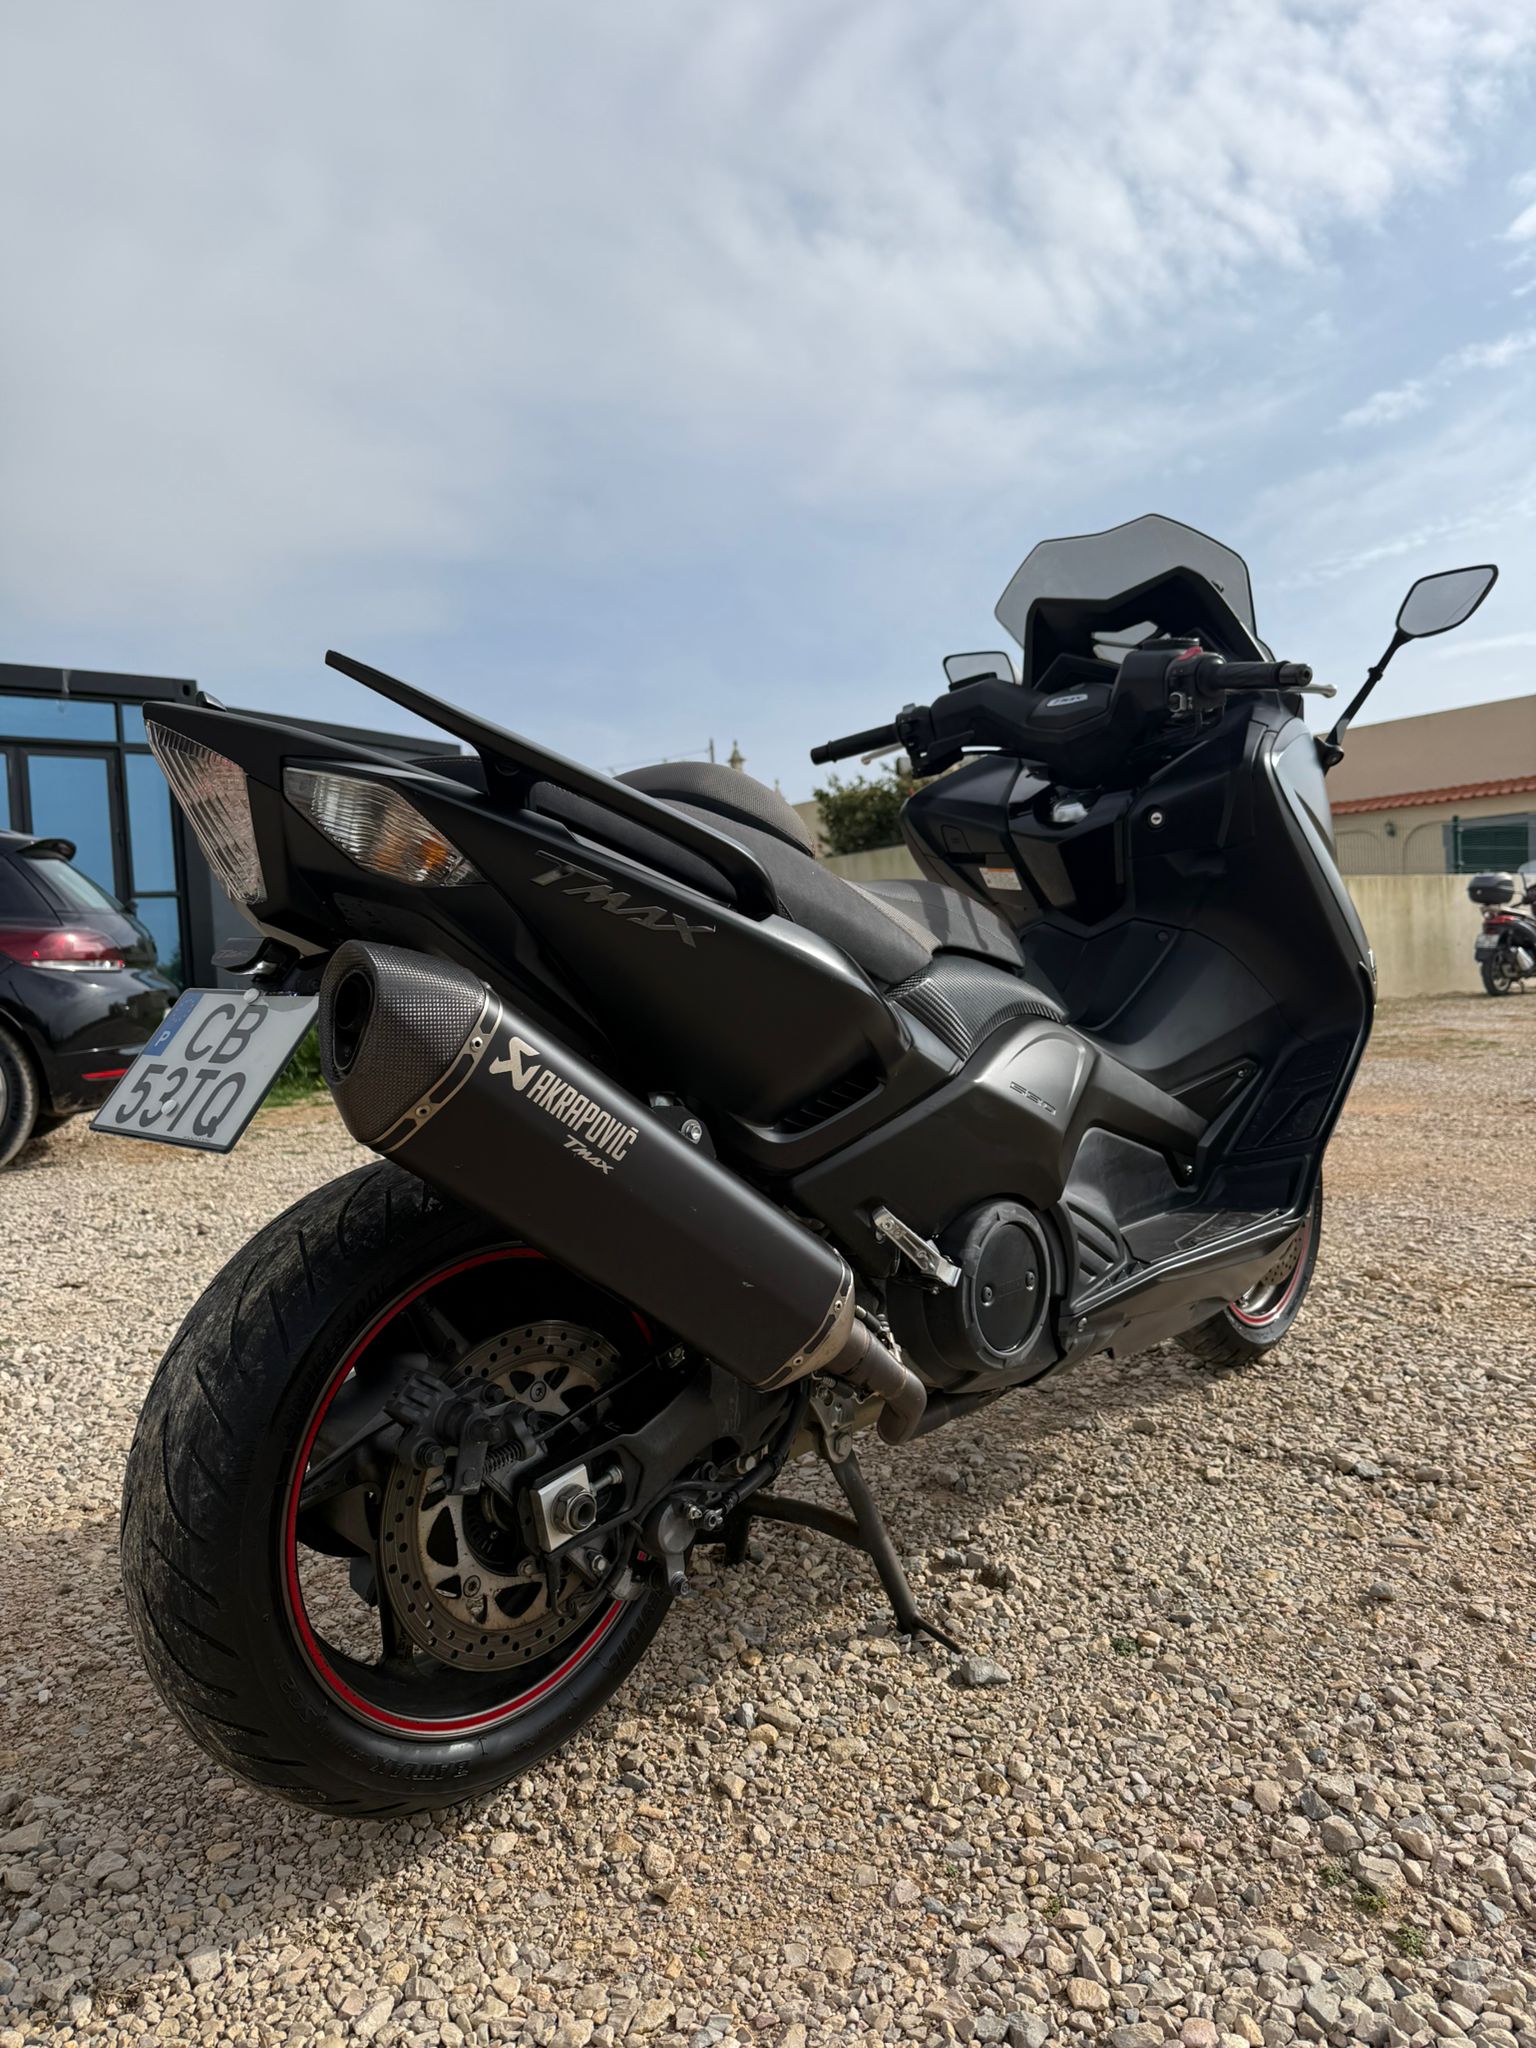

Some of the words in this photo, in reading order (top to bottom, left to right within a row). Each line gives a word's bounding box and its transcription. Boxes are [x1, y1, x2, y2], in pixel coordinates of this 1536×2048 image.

[530, 850, 716, 948] TMAX
[154, 1030, 171, 1047] P
[184, 1003, 269, 1064] CB
[115, 1064, 247, 1138] 53TQ
[563, 1134, 614, 1175] TMAX
